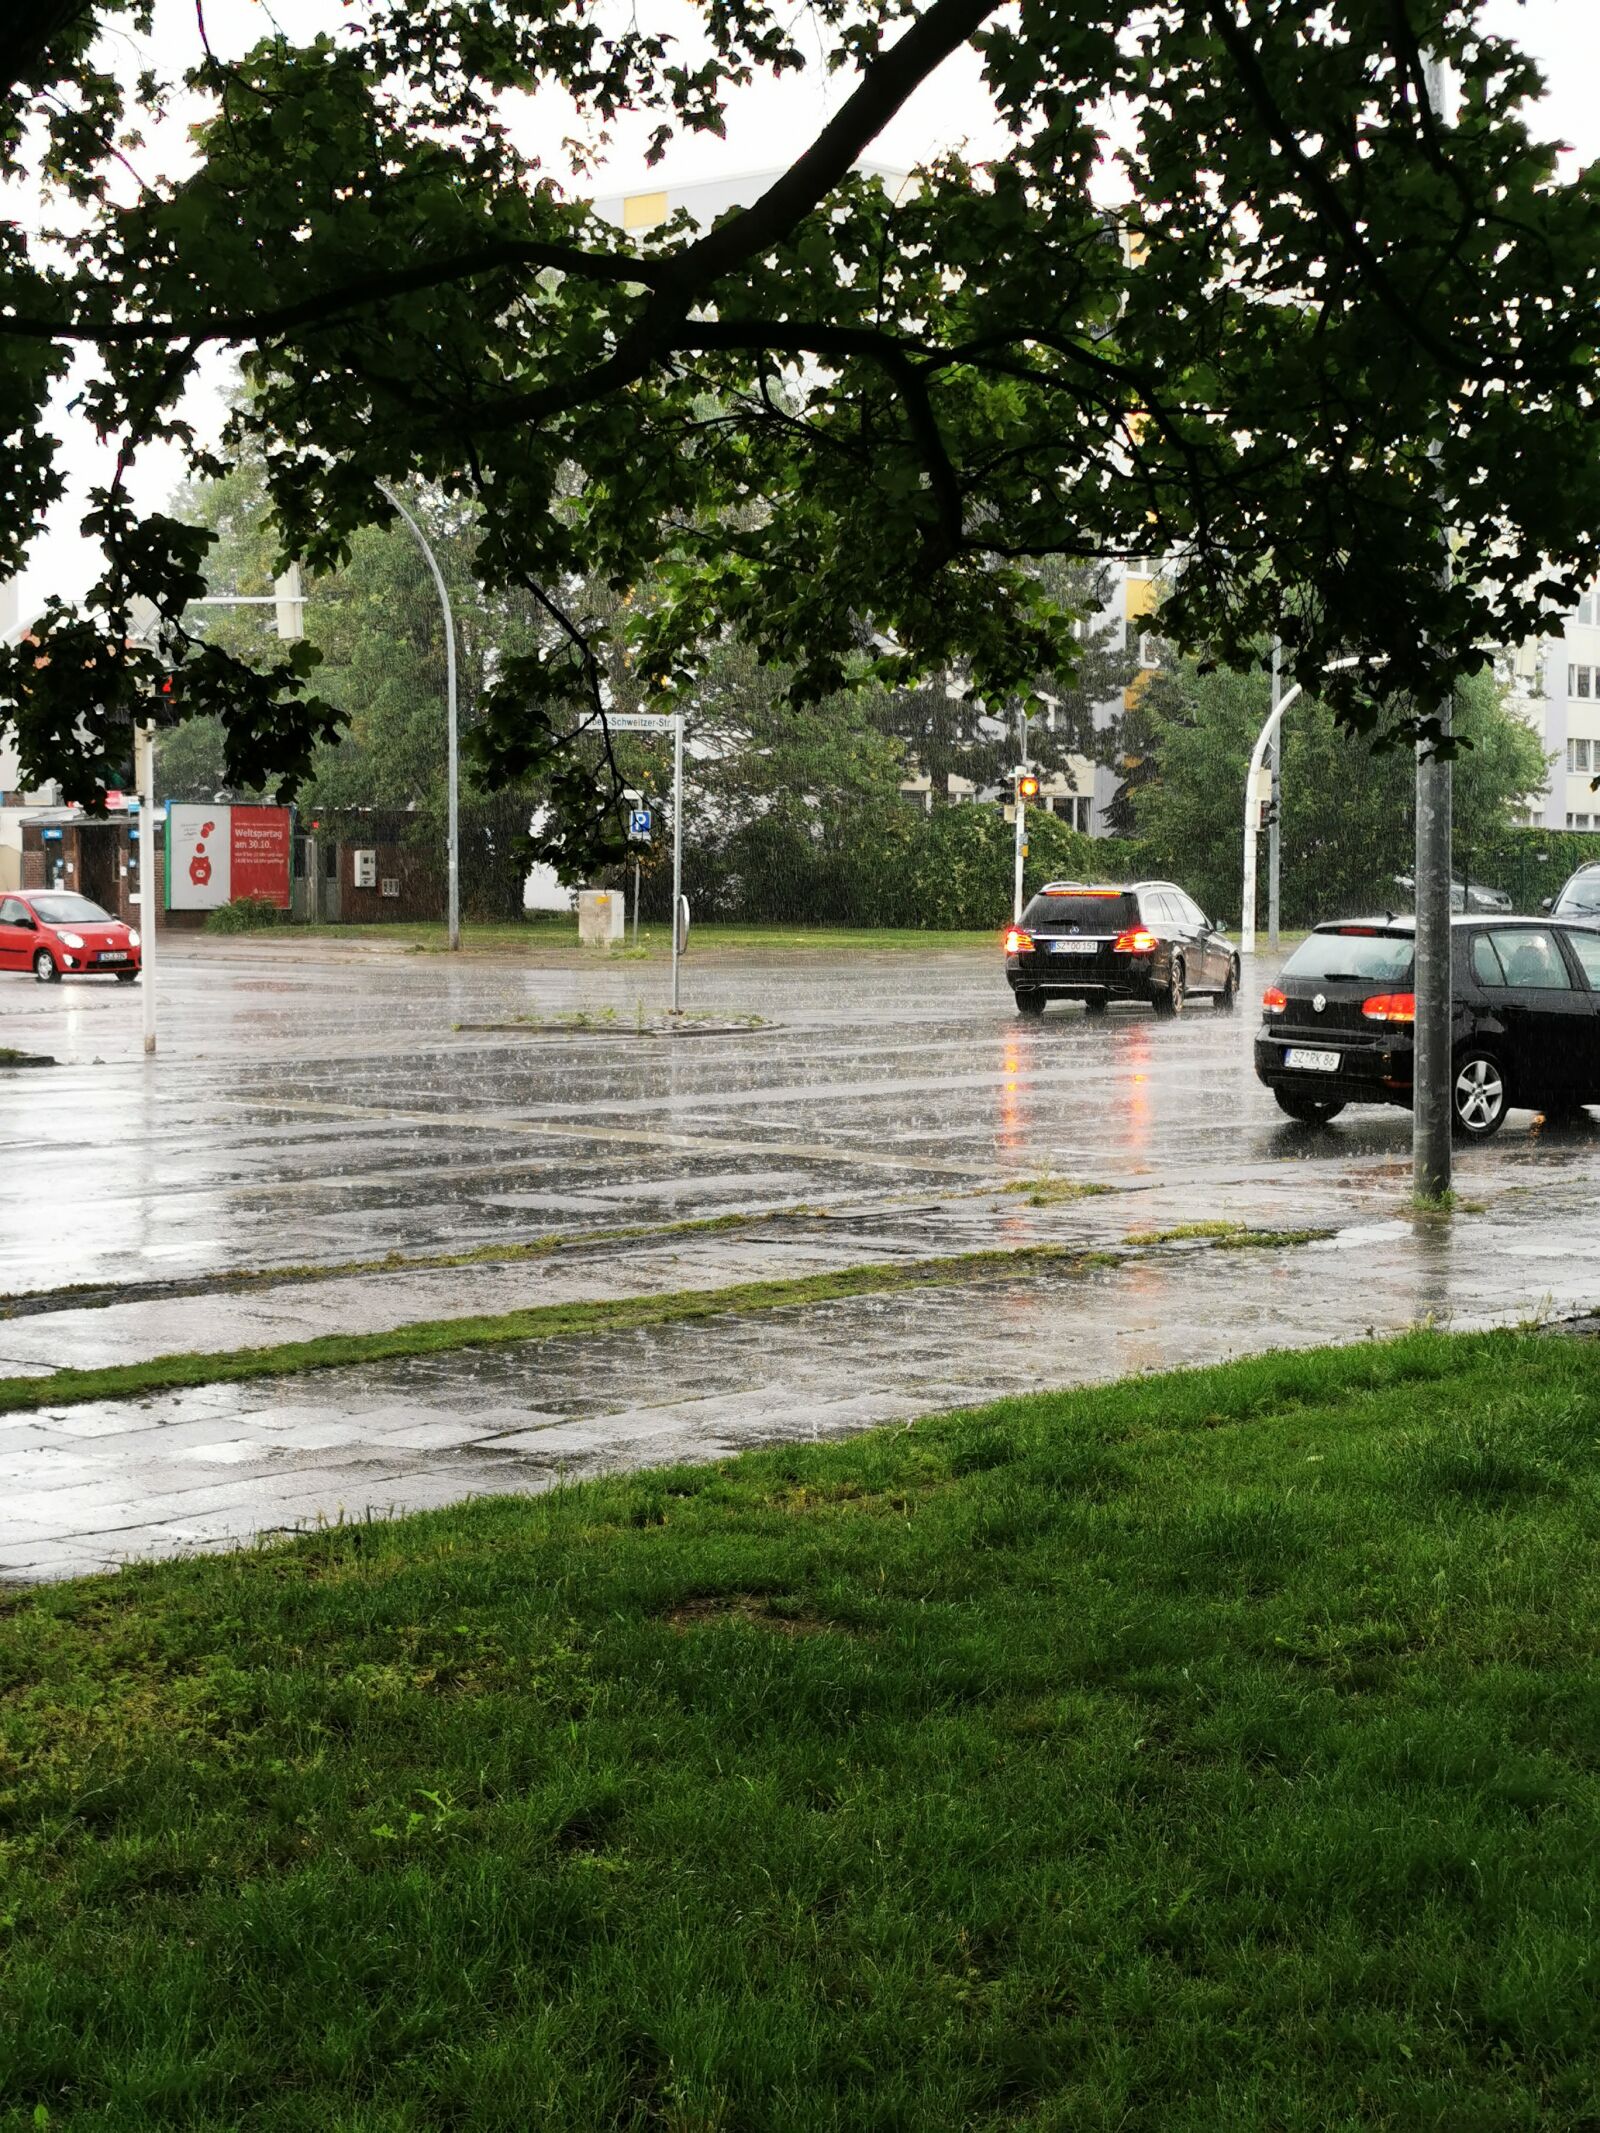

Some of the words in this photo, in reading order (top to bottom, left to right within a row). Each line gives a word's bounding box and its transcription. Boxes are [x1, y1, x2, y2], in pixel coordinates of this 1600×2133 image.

[634, 813, 647, 831] P
[234, 828, 283, 840] Weltspartag
[234, 841, 247, 849] am
[249, 839, 272, 849] 30.10.
[1293, 1051, 1305, 1064] SZ
[1323, 1054, 1335, 1066] 86
